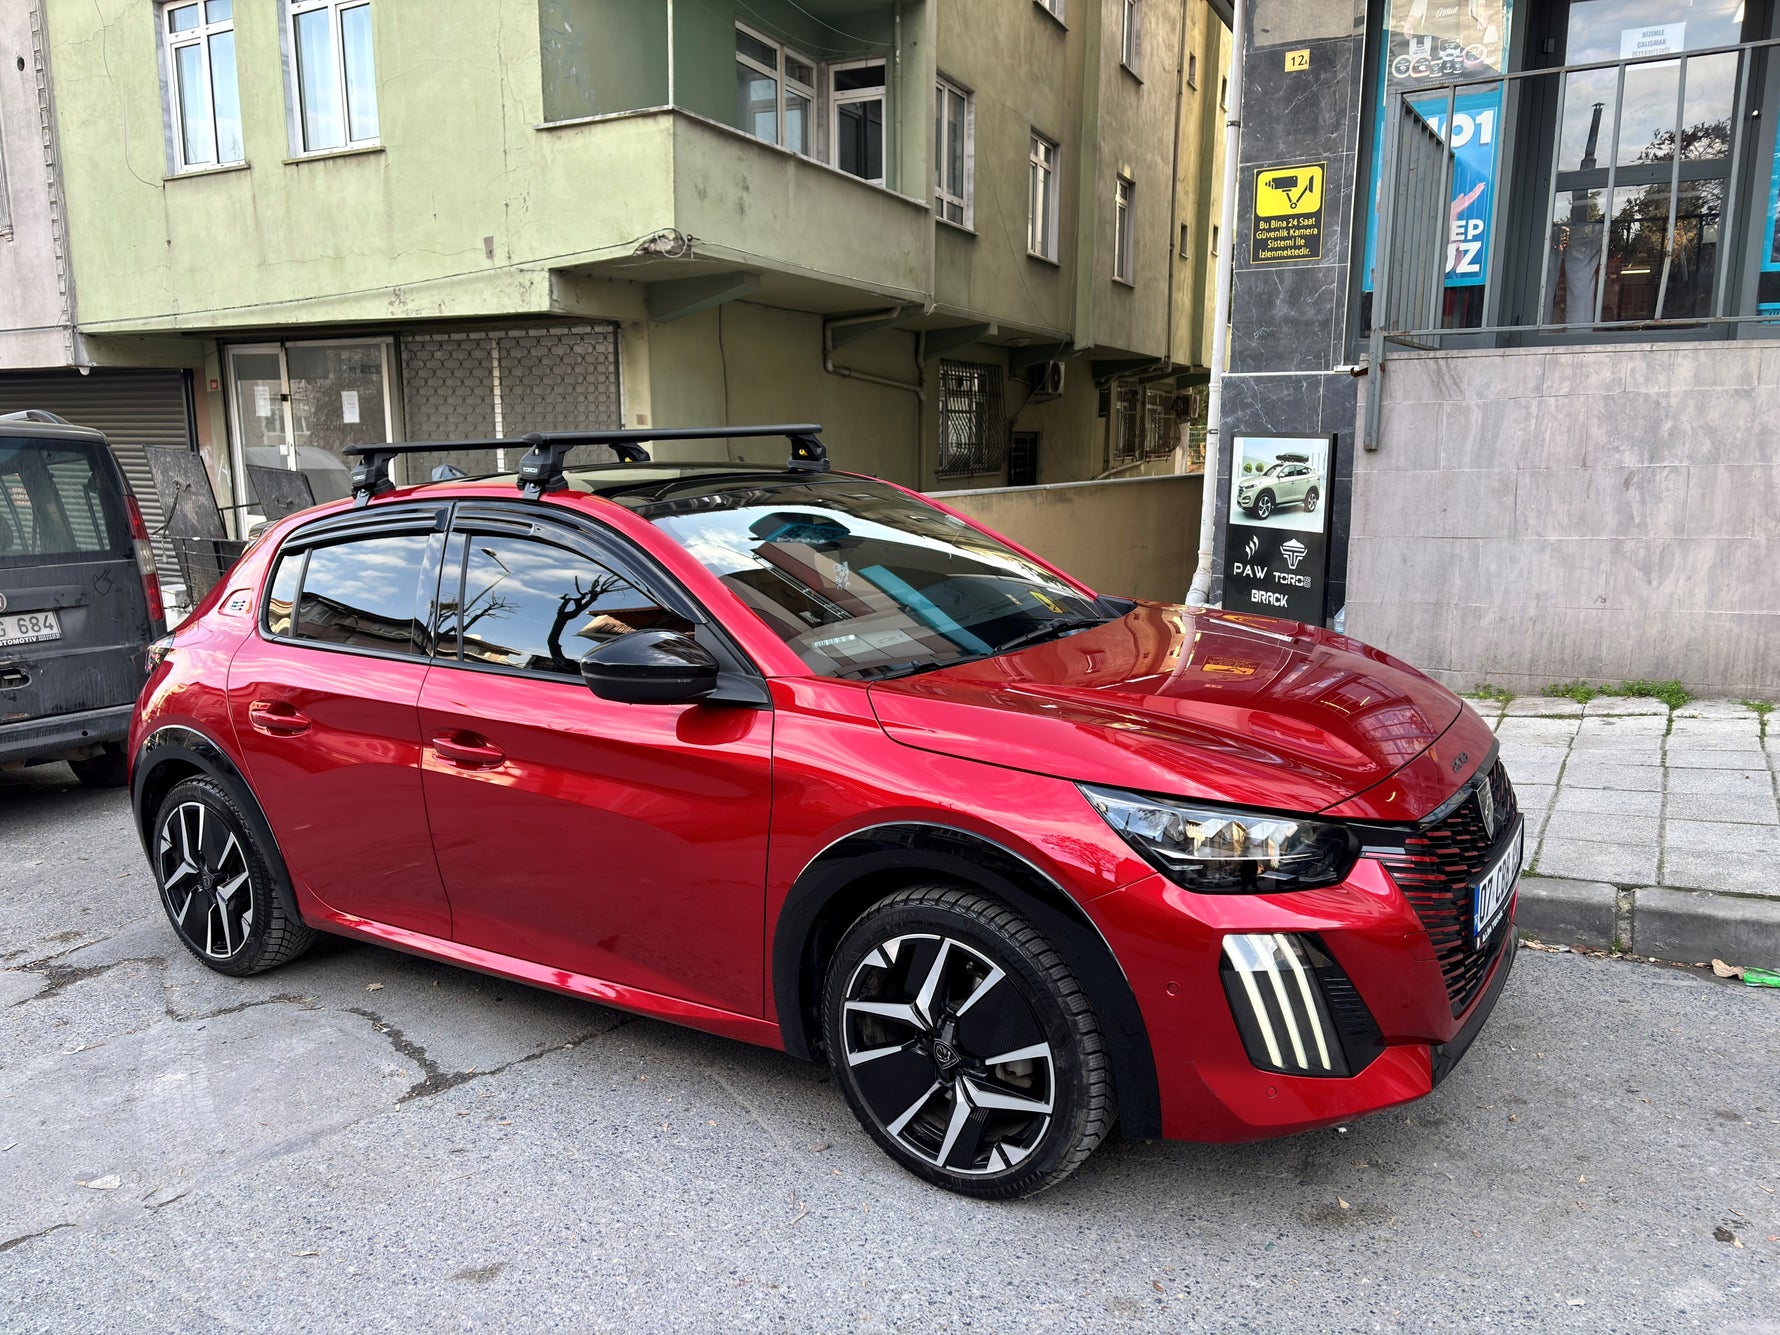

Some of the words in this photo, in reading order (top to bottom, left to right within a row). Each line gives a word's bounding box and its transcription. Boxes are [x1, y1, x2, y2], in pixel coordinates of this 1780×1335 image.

[1259, 221, 1269, 229] Bu
[1270, 219, 1287, 228] Bina
[1288, 218, 1298, 227] 24
[1299, 217, 1316, 226] Saat
[1256, 229, 1288, 239] Güvenlik
[1289, 228, 1318, 236] Kamera
[1267, 239, 1294, 248] Sistemi
[1233, 562, 1268, 580] PAW
[1251, 589, 1288, 608] BRACK
[17, 614, 54, 634] 684
[1480, 874, 1493, 923] 07
